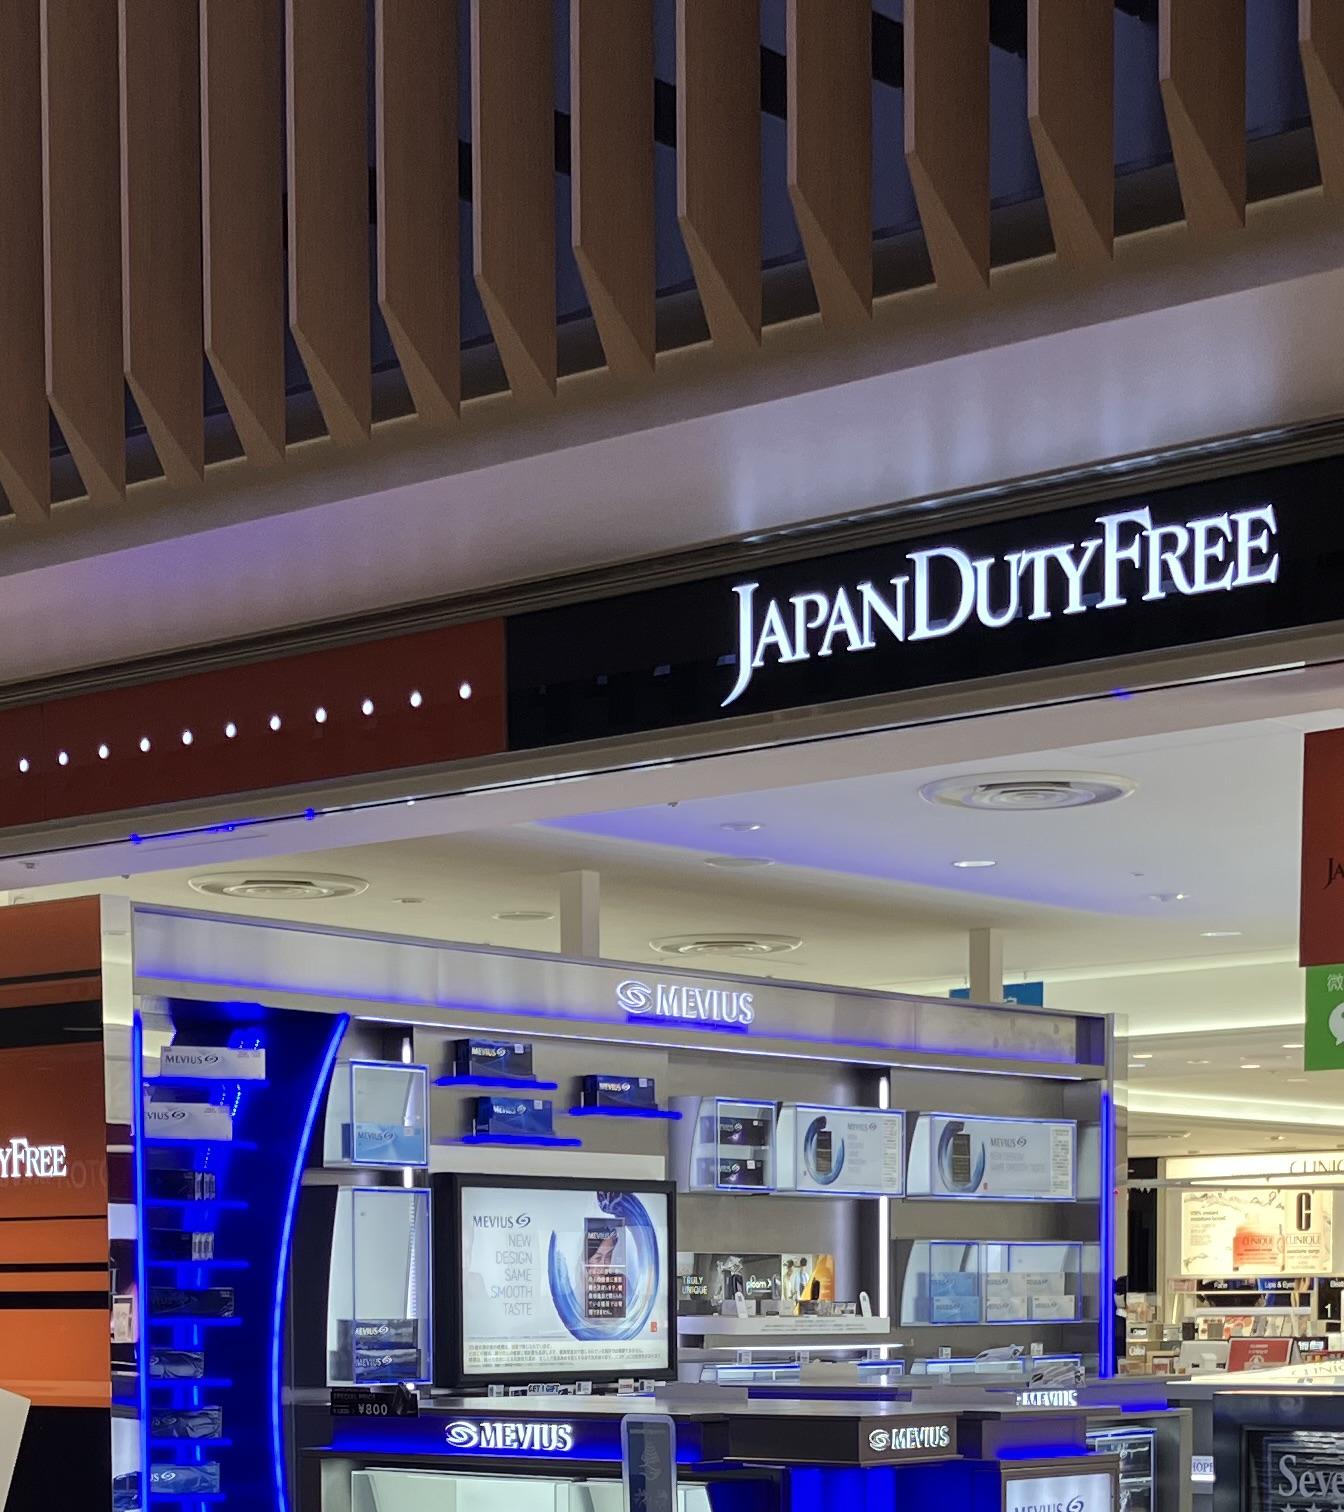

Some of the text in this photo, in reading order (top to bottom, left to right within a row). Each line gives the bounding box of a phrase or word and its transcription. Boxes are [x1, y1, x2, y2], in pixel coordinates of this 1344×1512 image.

[656, 982, 755, 1026] MEVIUS
[165, 1054, 203, 1065] MEVIUS
[472, 1215, 514, 1229] MEVIUS
[508, 1233, 532, 1248] NEW
[1242, 1236, 1273, 1245] CLINIQUE
[1285, 1235, 1321, 1244] CLINIQUE
[495, 1251, 533, 1265] DESIGN
[505, 1268, 532, 1282] SAME
[682, 1276, 703, 1285] TRULY
[491, 1285, 533, 1299] SMOOTH
[682, 1286, 708, 1295] UNIQUE
[505, 1302, 532, 1316] TASTE
[1324, 1304, 1332, 1318] 1
[358, 1403, 388, 1416] ¥800
[479, 1421, 573, 1452] MEVIUS
[891, 1424, 950, 1451] MEVIUS
